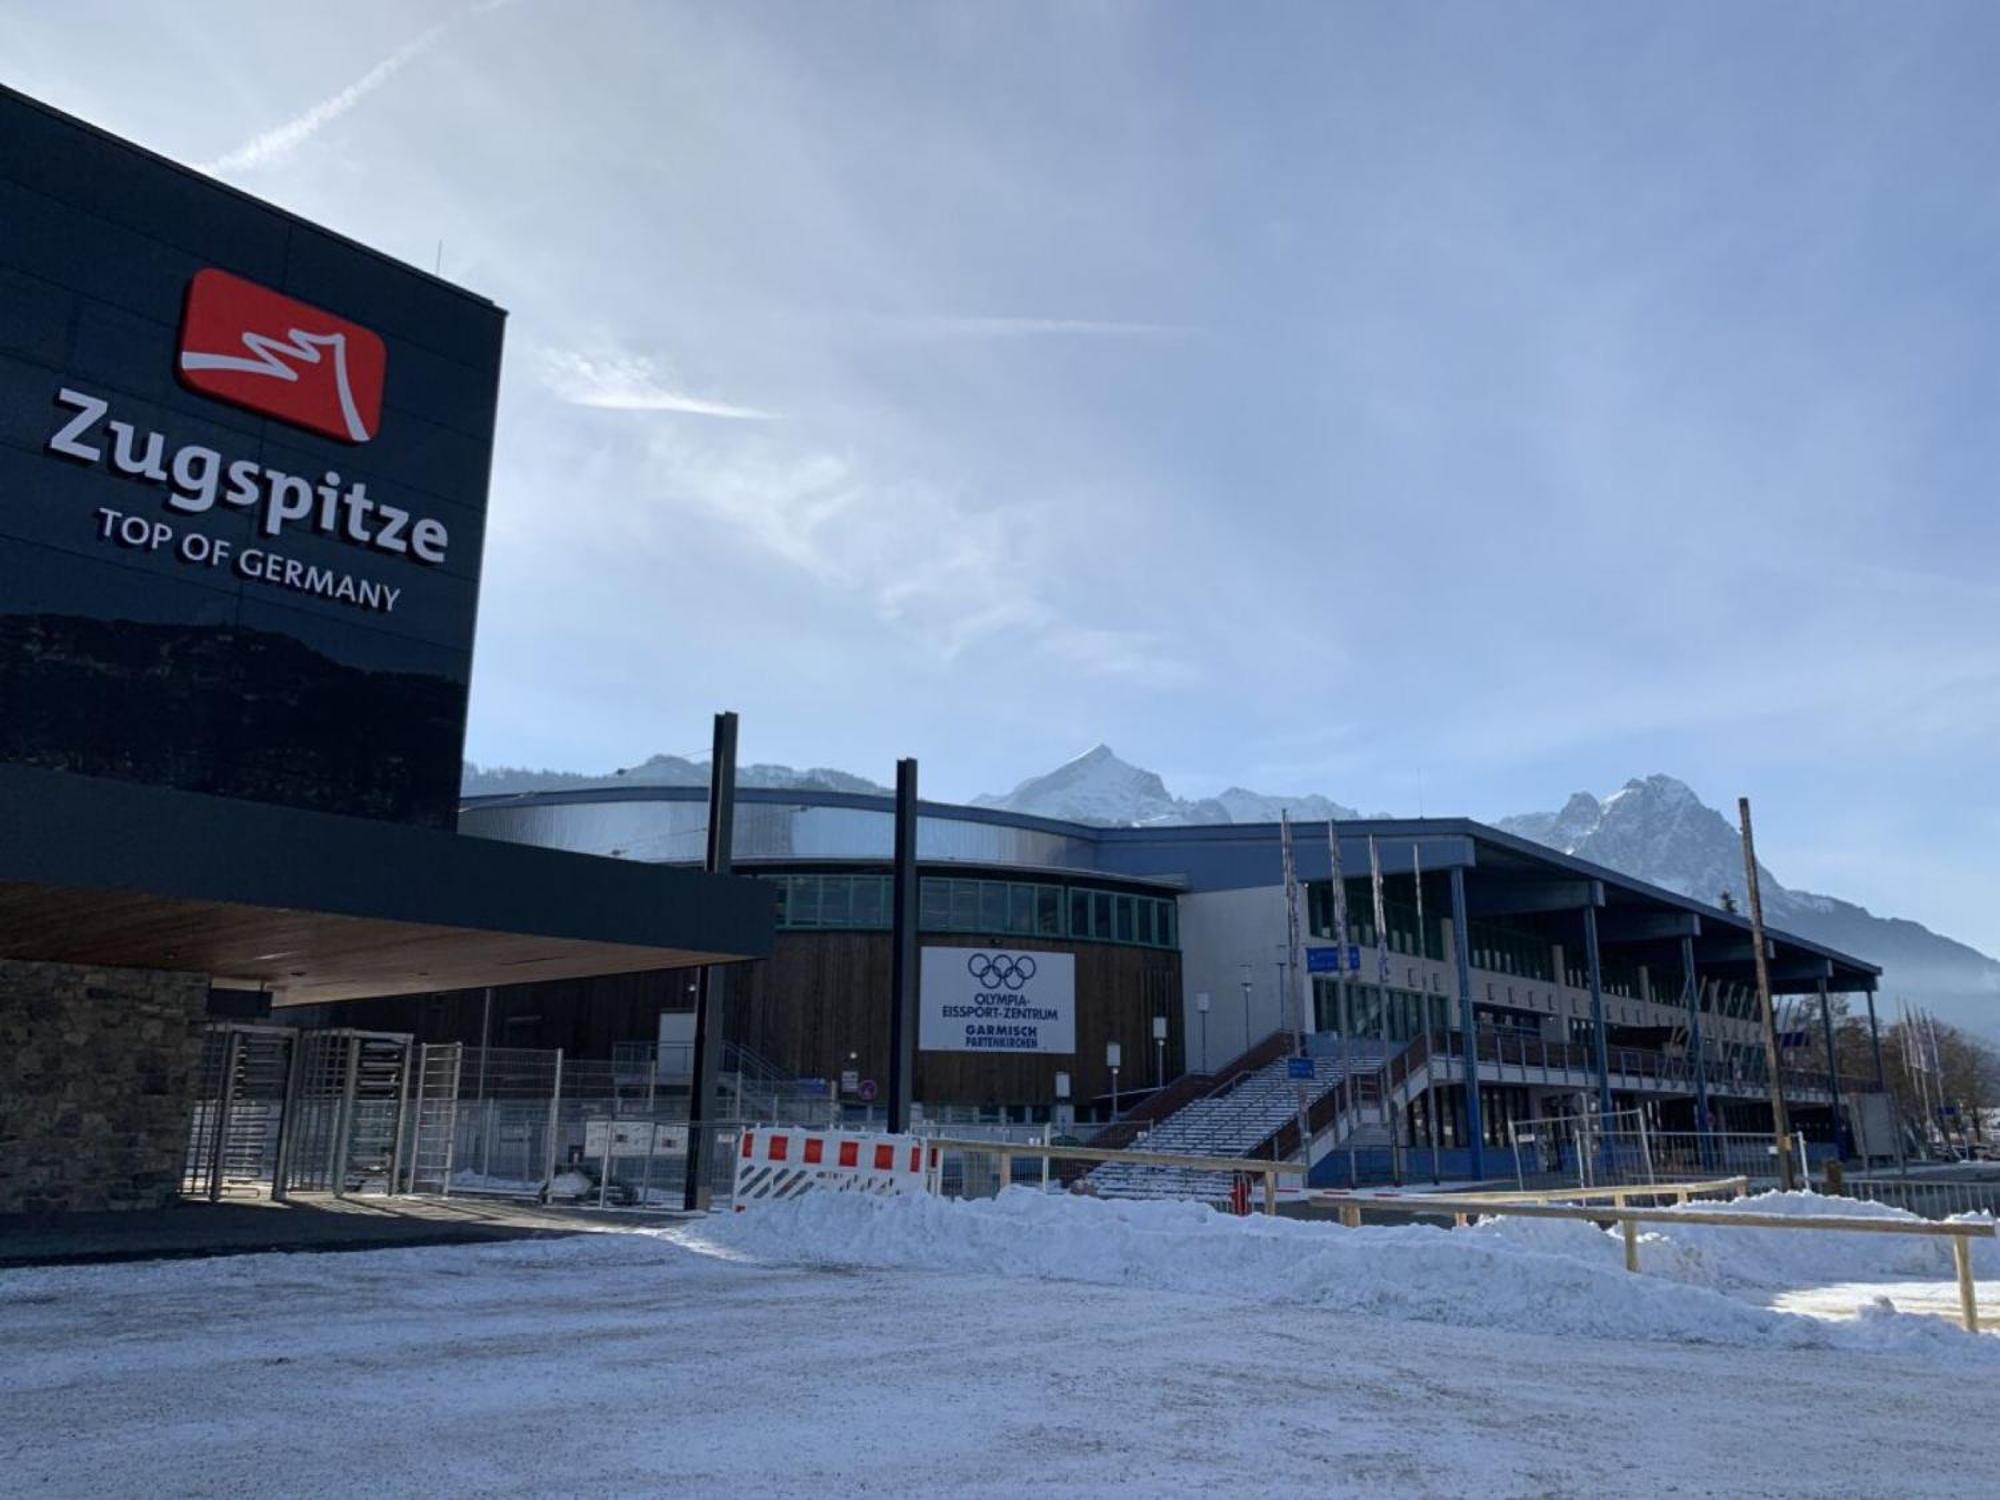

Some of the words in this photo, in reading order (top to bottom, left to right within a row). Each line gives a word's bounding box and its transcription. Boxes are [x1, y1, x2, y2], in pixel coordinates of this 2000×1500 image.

[49, 387, 449, 564] Zugspitze
[98, 507, 172, 550] TOP
[182, 534, 230, 566] OF
[239, 548, 401, 613] GERMANY
[974, 993, 1030, 1006] OLYMPIA-
[942, 1005, 1058, 1021] EISSPORT-ZENTRUM
[965, 1024, 1037, 1037] GARMISCH
[965, 1036, 1038, 1048] PARTENKIRCHEN
